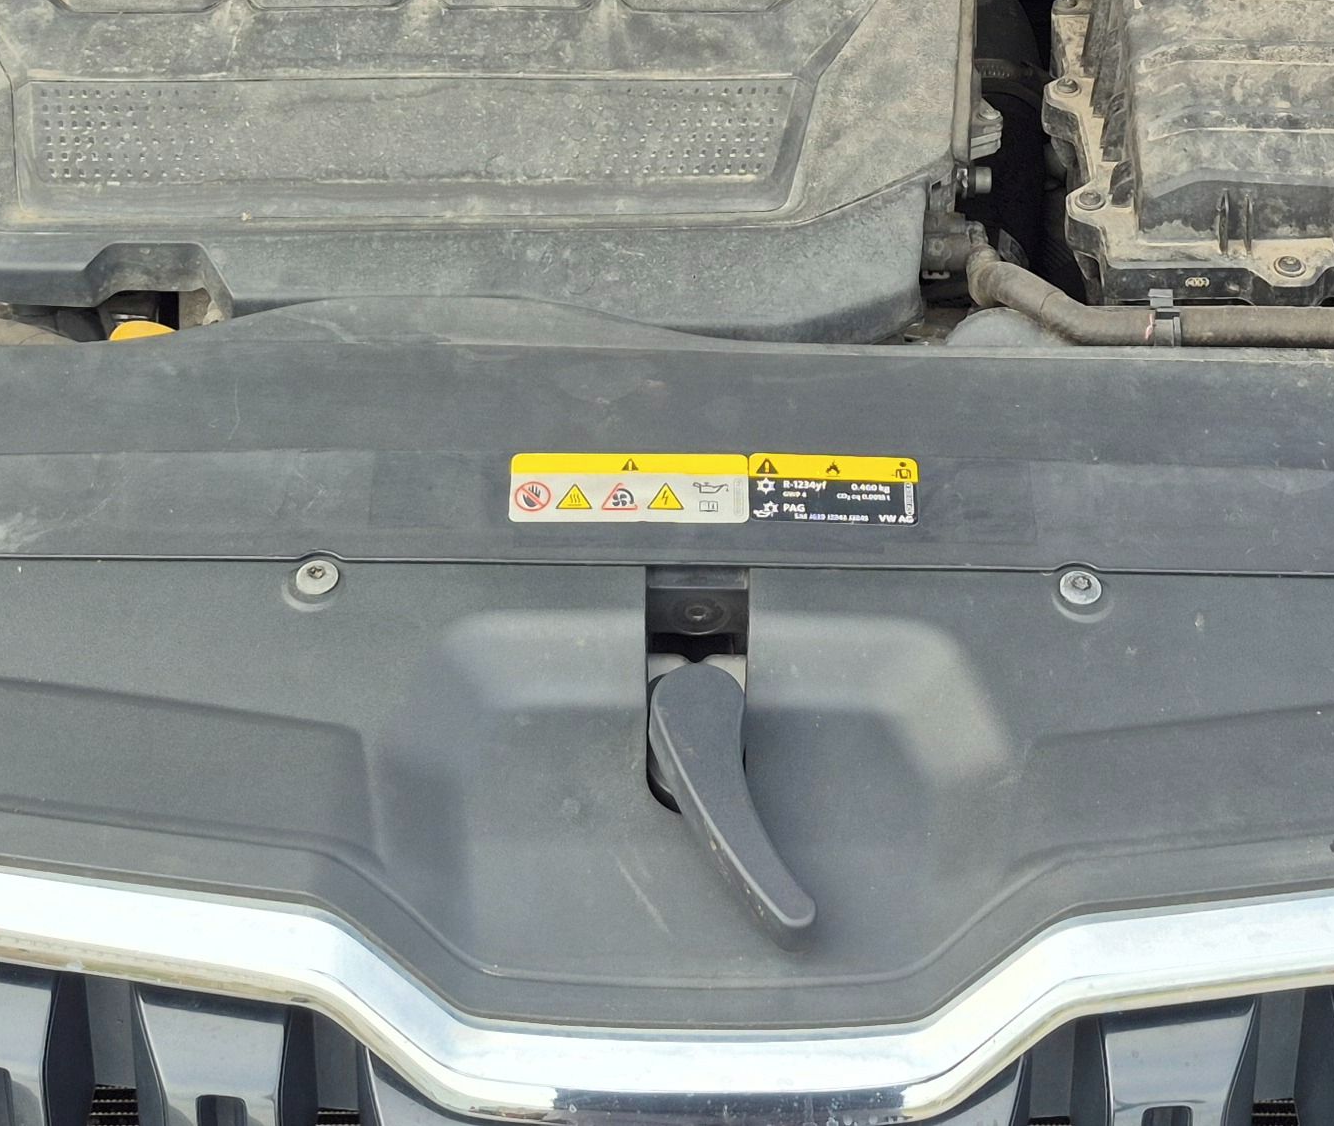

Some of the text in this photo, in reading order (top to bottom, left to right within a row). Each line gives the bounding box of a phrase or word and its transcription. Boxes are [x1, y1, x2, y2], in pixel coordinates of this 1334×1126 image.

[783, 480, 827, 491] R-1234yf
[878, 484, 890, 494] kg
[783, 504, 806, 512] PAG
[878, 514, 915, 524] VW AG
